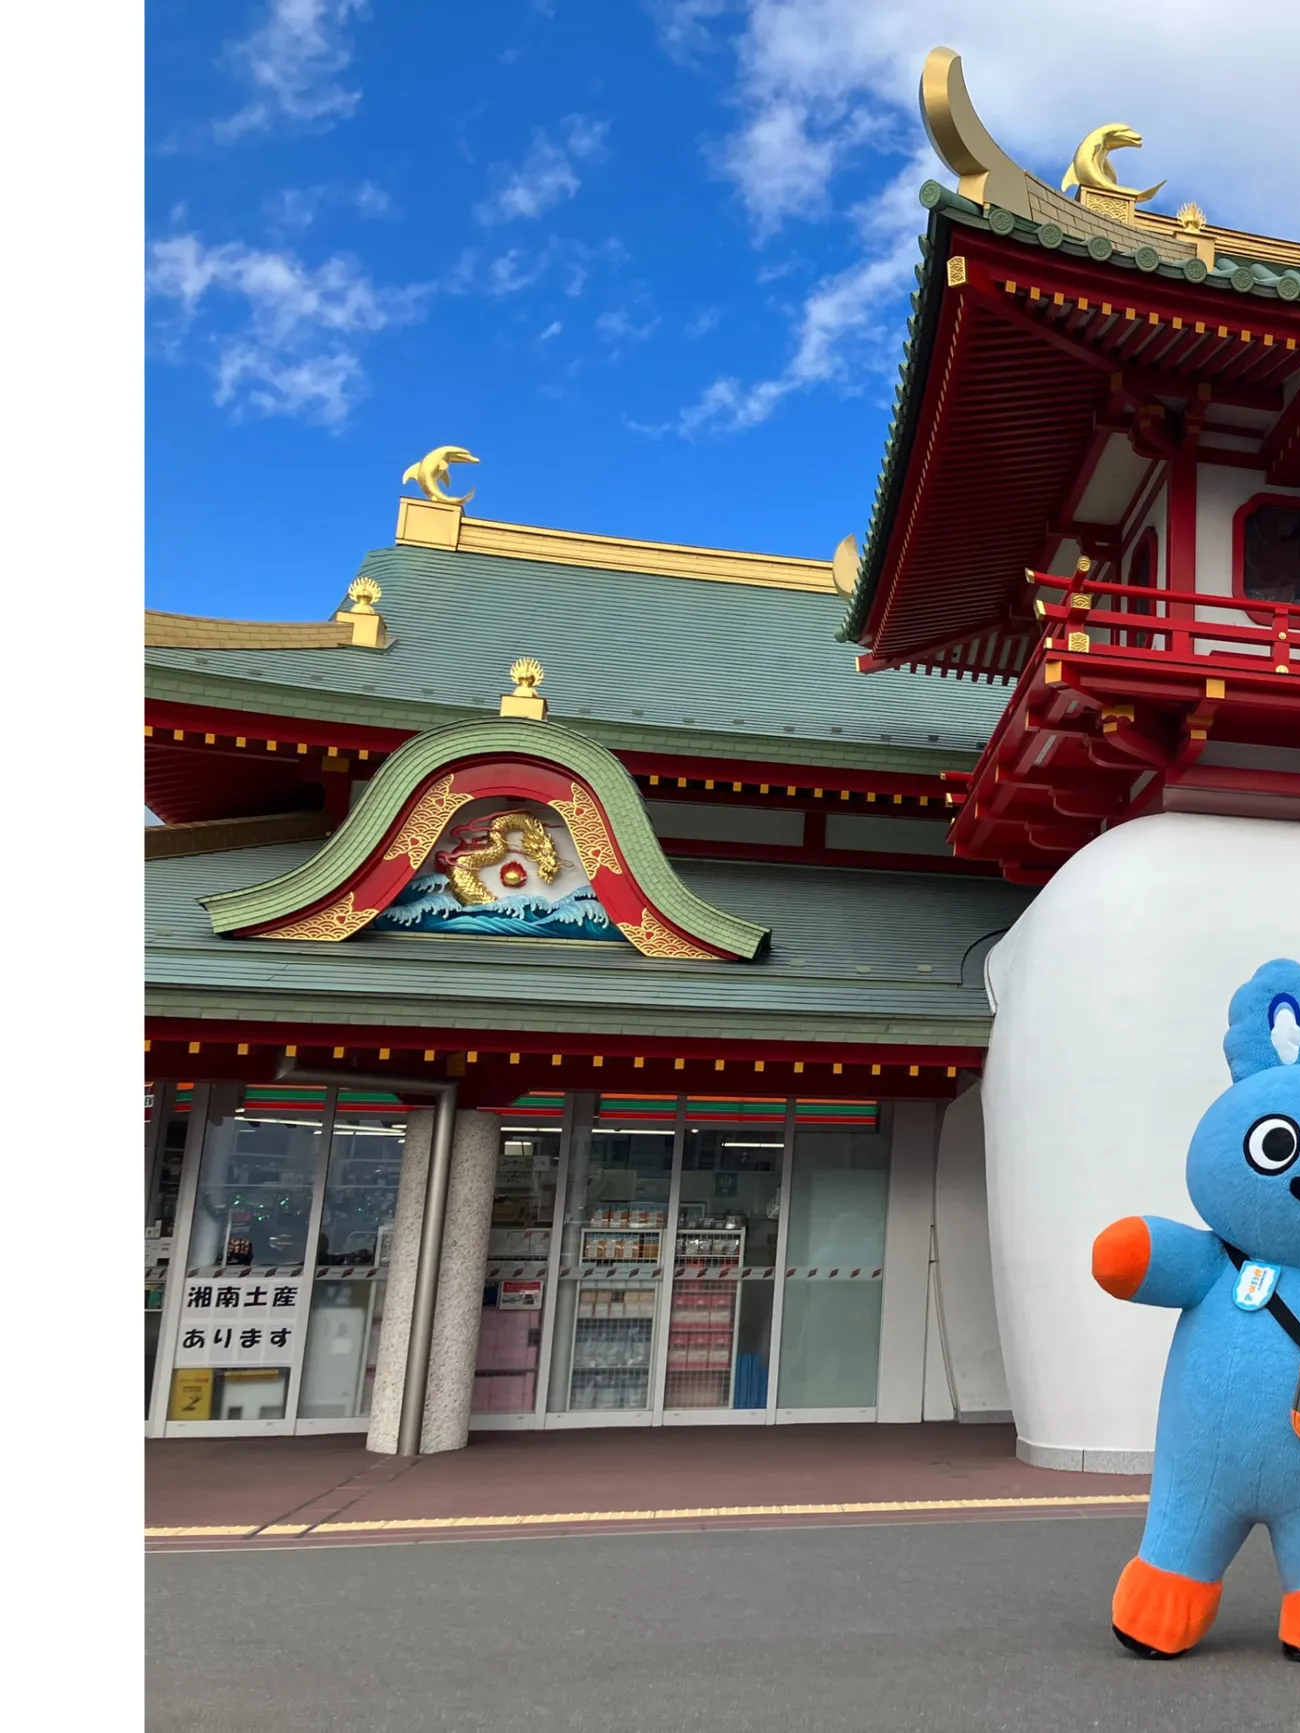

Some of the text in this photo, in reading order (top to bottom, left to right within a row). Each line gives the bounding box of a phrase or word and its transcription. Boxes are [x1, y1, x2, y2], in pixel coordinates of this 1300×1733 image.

[186, 1285, 299, 1308] 湘南土産
[182, 1327, 292, 1349] あります
